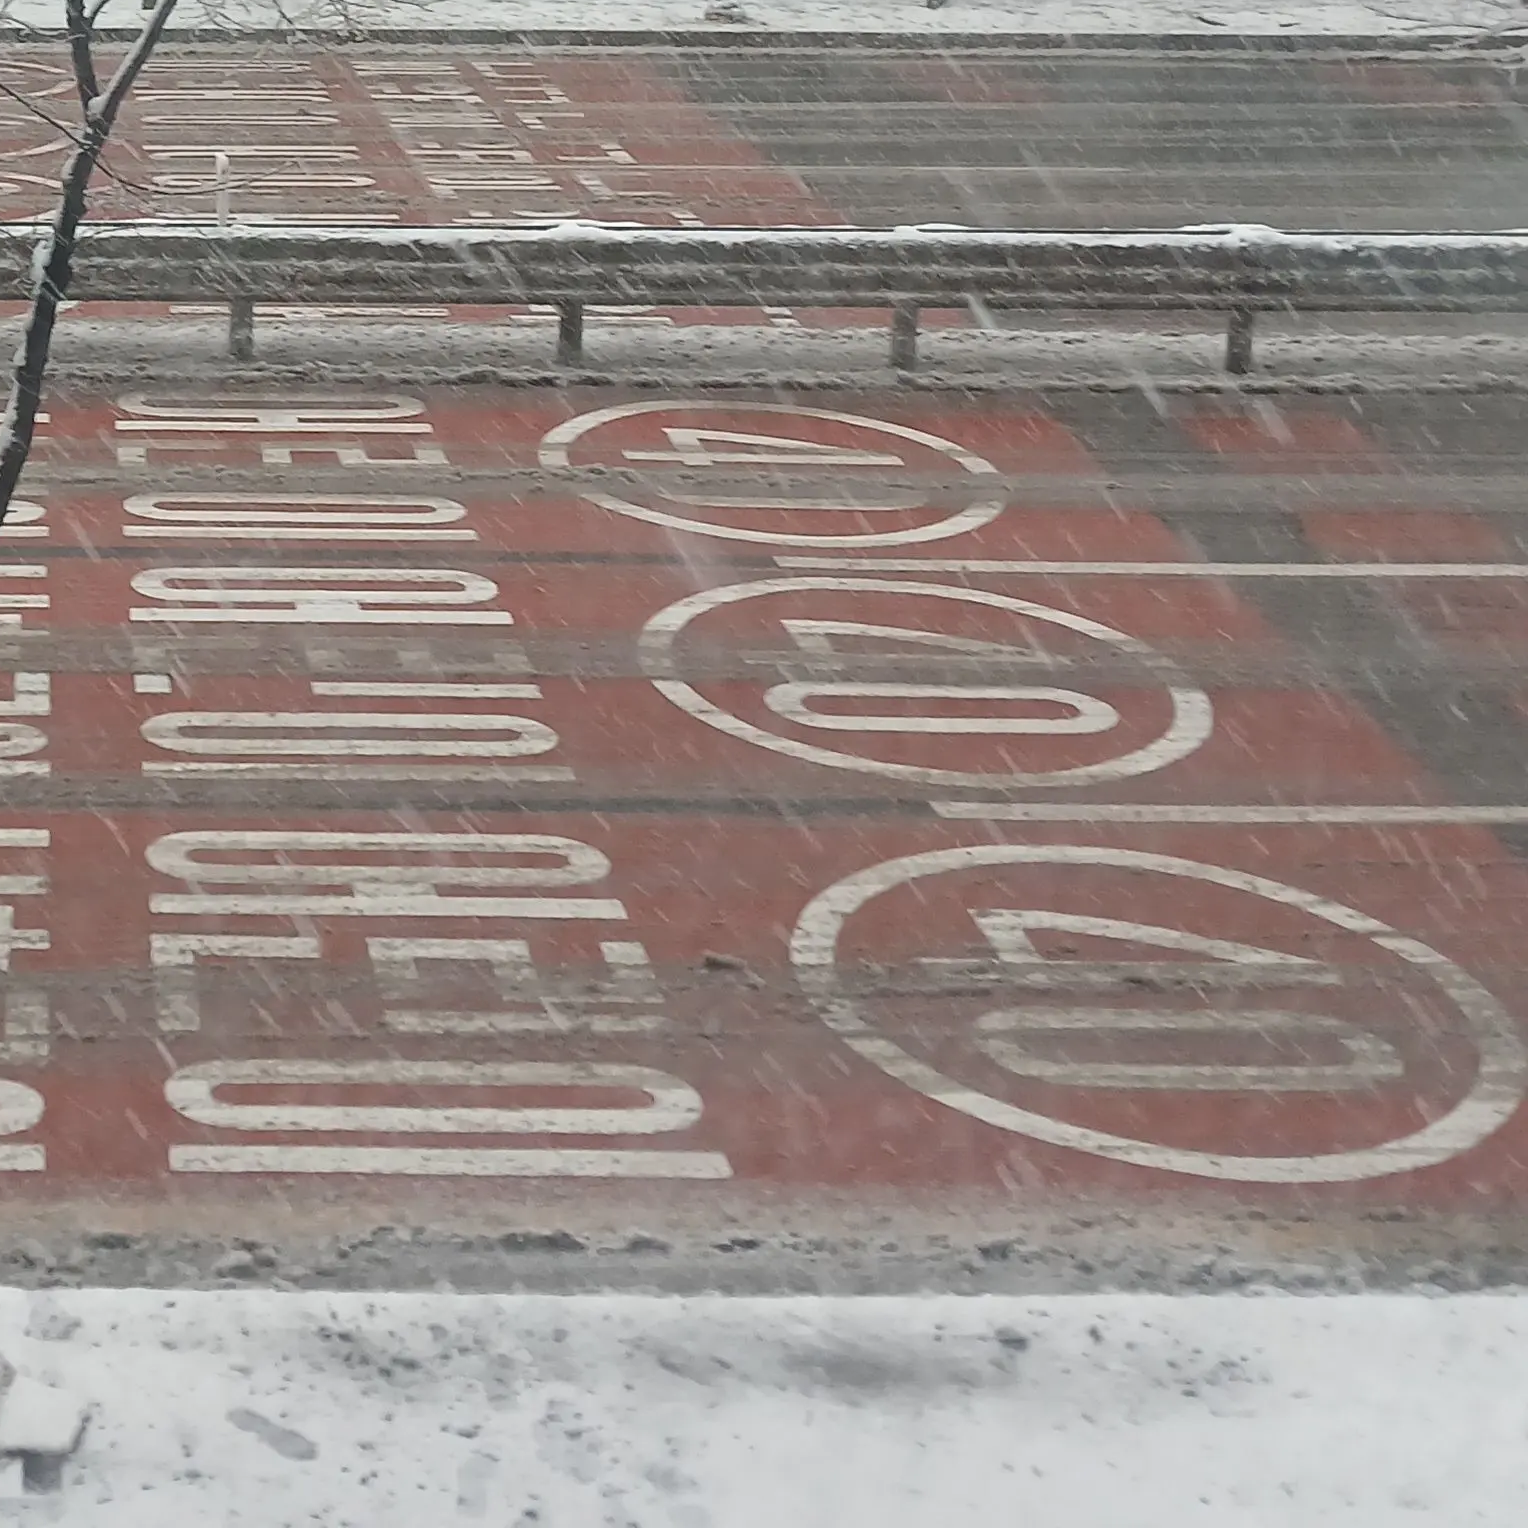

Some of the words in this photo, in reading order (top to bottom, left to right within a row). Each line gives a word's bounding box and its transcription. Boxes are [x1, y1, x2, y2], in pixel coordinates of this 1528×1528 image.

[742, 618, 1119, 734] 40
[144, 829, 734, 1178] 어린이
[916, 907, 1405, 1091] 40
